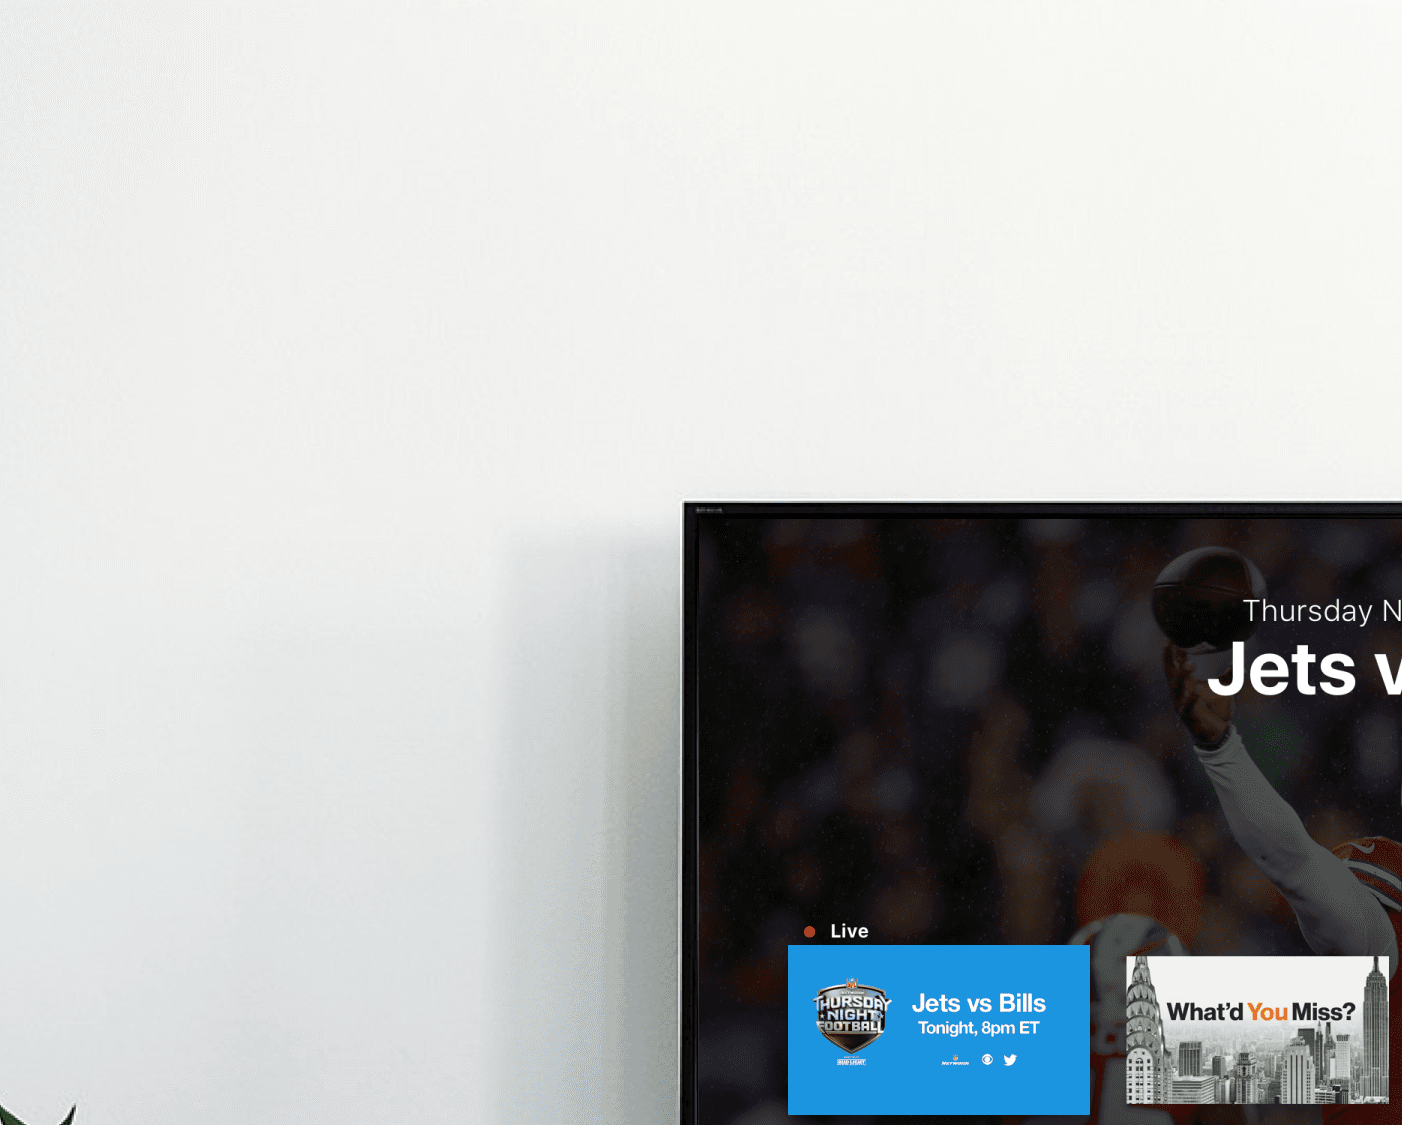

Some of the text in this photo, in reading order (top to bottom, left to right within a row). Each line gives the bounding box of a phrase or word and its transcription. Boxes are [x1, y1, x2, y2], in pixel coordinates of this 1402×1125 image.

[1243, 599, 1373, 628] Thursday
[1207, 640, 1356, 697] Jets
[831, 923, 869, 939] Live
[812, 995, 893, 1012] THURSDAY
[911, 993, 1047, 1013] Jets vs Bills
[1248, 1002, 1288, 1021] You
[1292, 1002, 1357, 1021] Miss?
[827, 1009, 876, 1021] NIGHT
[815, 1021, 885, 1034] FOOTBALL
[918, 1020, 1041, 1038] Tonight, 8pm ET
